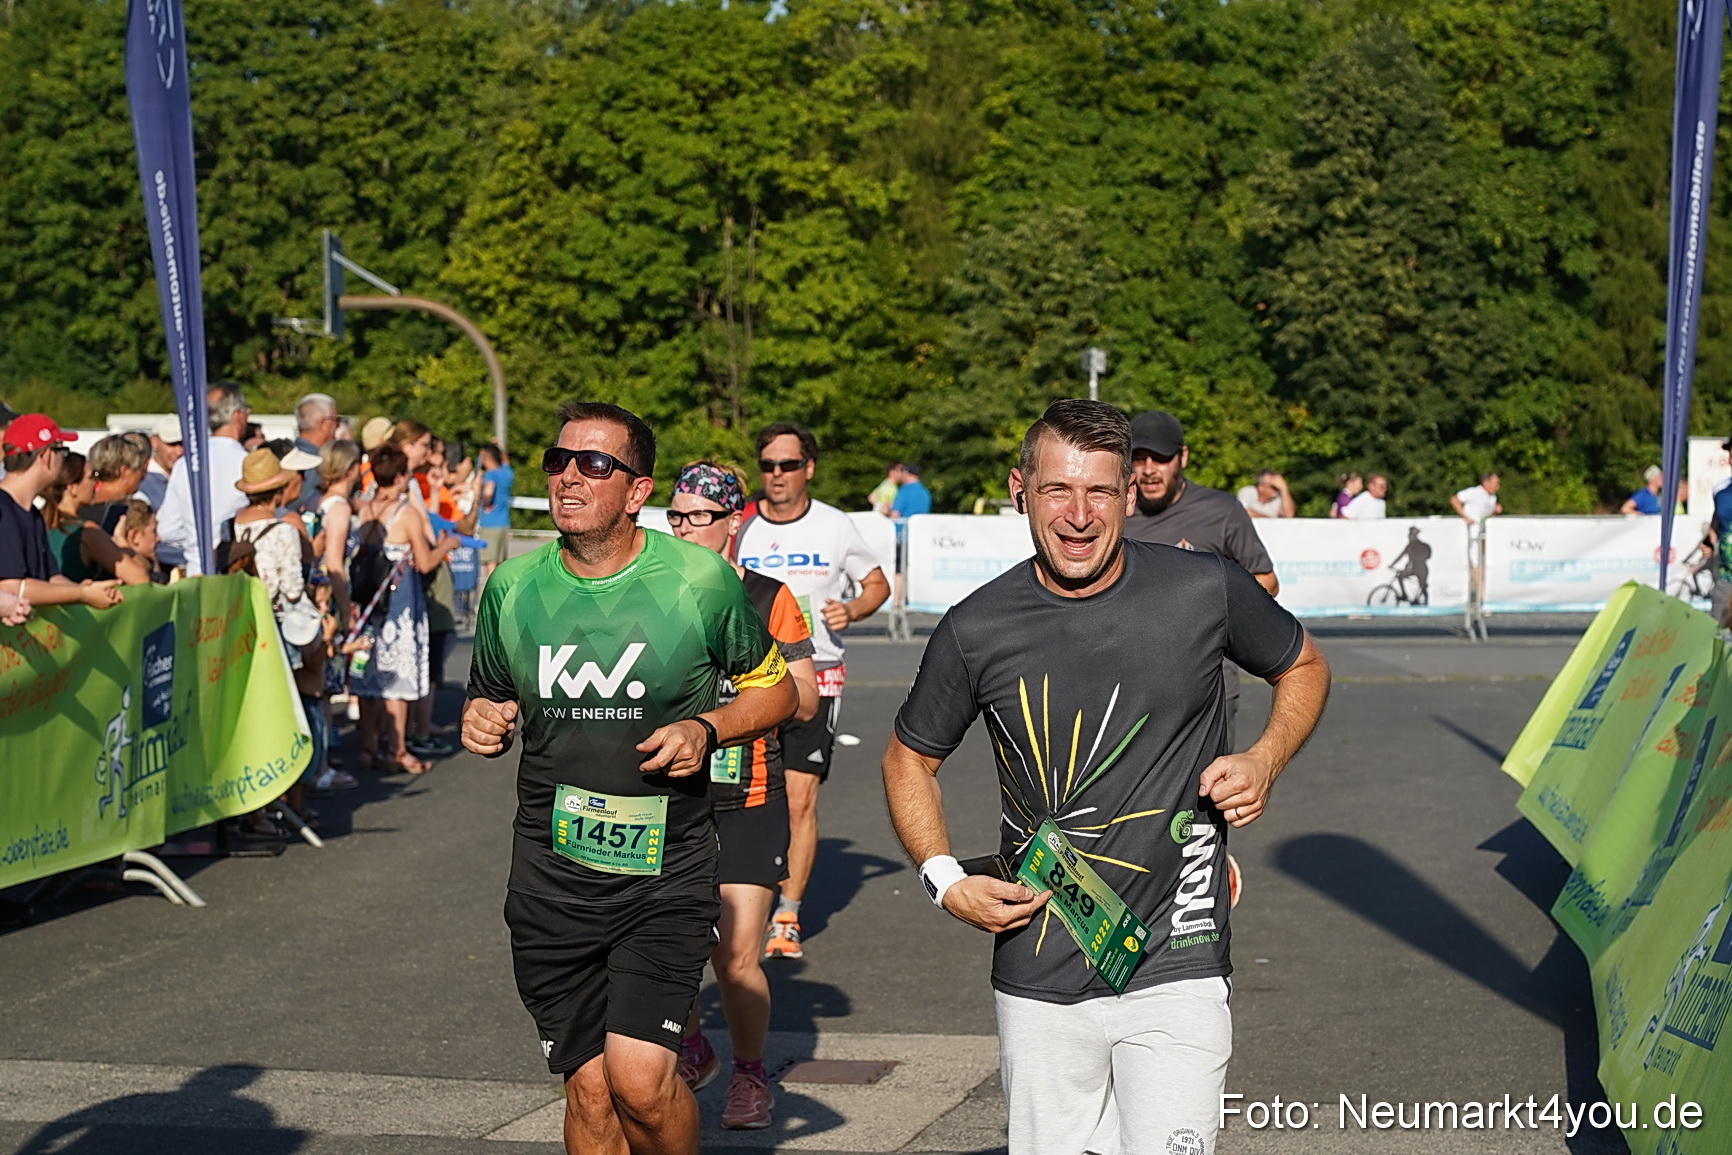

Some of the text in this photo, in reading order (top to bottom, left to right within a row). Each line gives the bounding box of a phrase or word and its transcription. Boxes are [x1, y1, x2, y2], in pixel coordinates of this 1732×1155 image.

[543, 707, 644, 720] KW ENERGIE
[582, 804, 618, 816] Firmenlauf
[557, 819, 568, 846] RUN
[571, 815, 648, 850] 1457
[566, 839, 647, 861] Fürnrieder Markus
[646, 828, 660, 865] 2022
[1029, 848, 1045, 874] RUN
[1049, 861, 1096, 919] 849
[1063, 899, 1090, 935] Marcus
[1173, 925, 1181, 933] by
[1090, 919, 1111, 953] 2022
[1170, 931, 1220, 950] drinknow.de
[661, 1018, 682, 1034] JAKO
[1181, 1135, 1195, 1145] 1971
